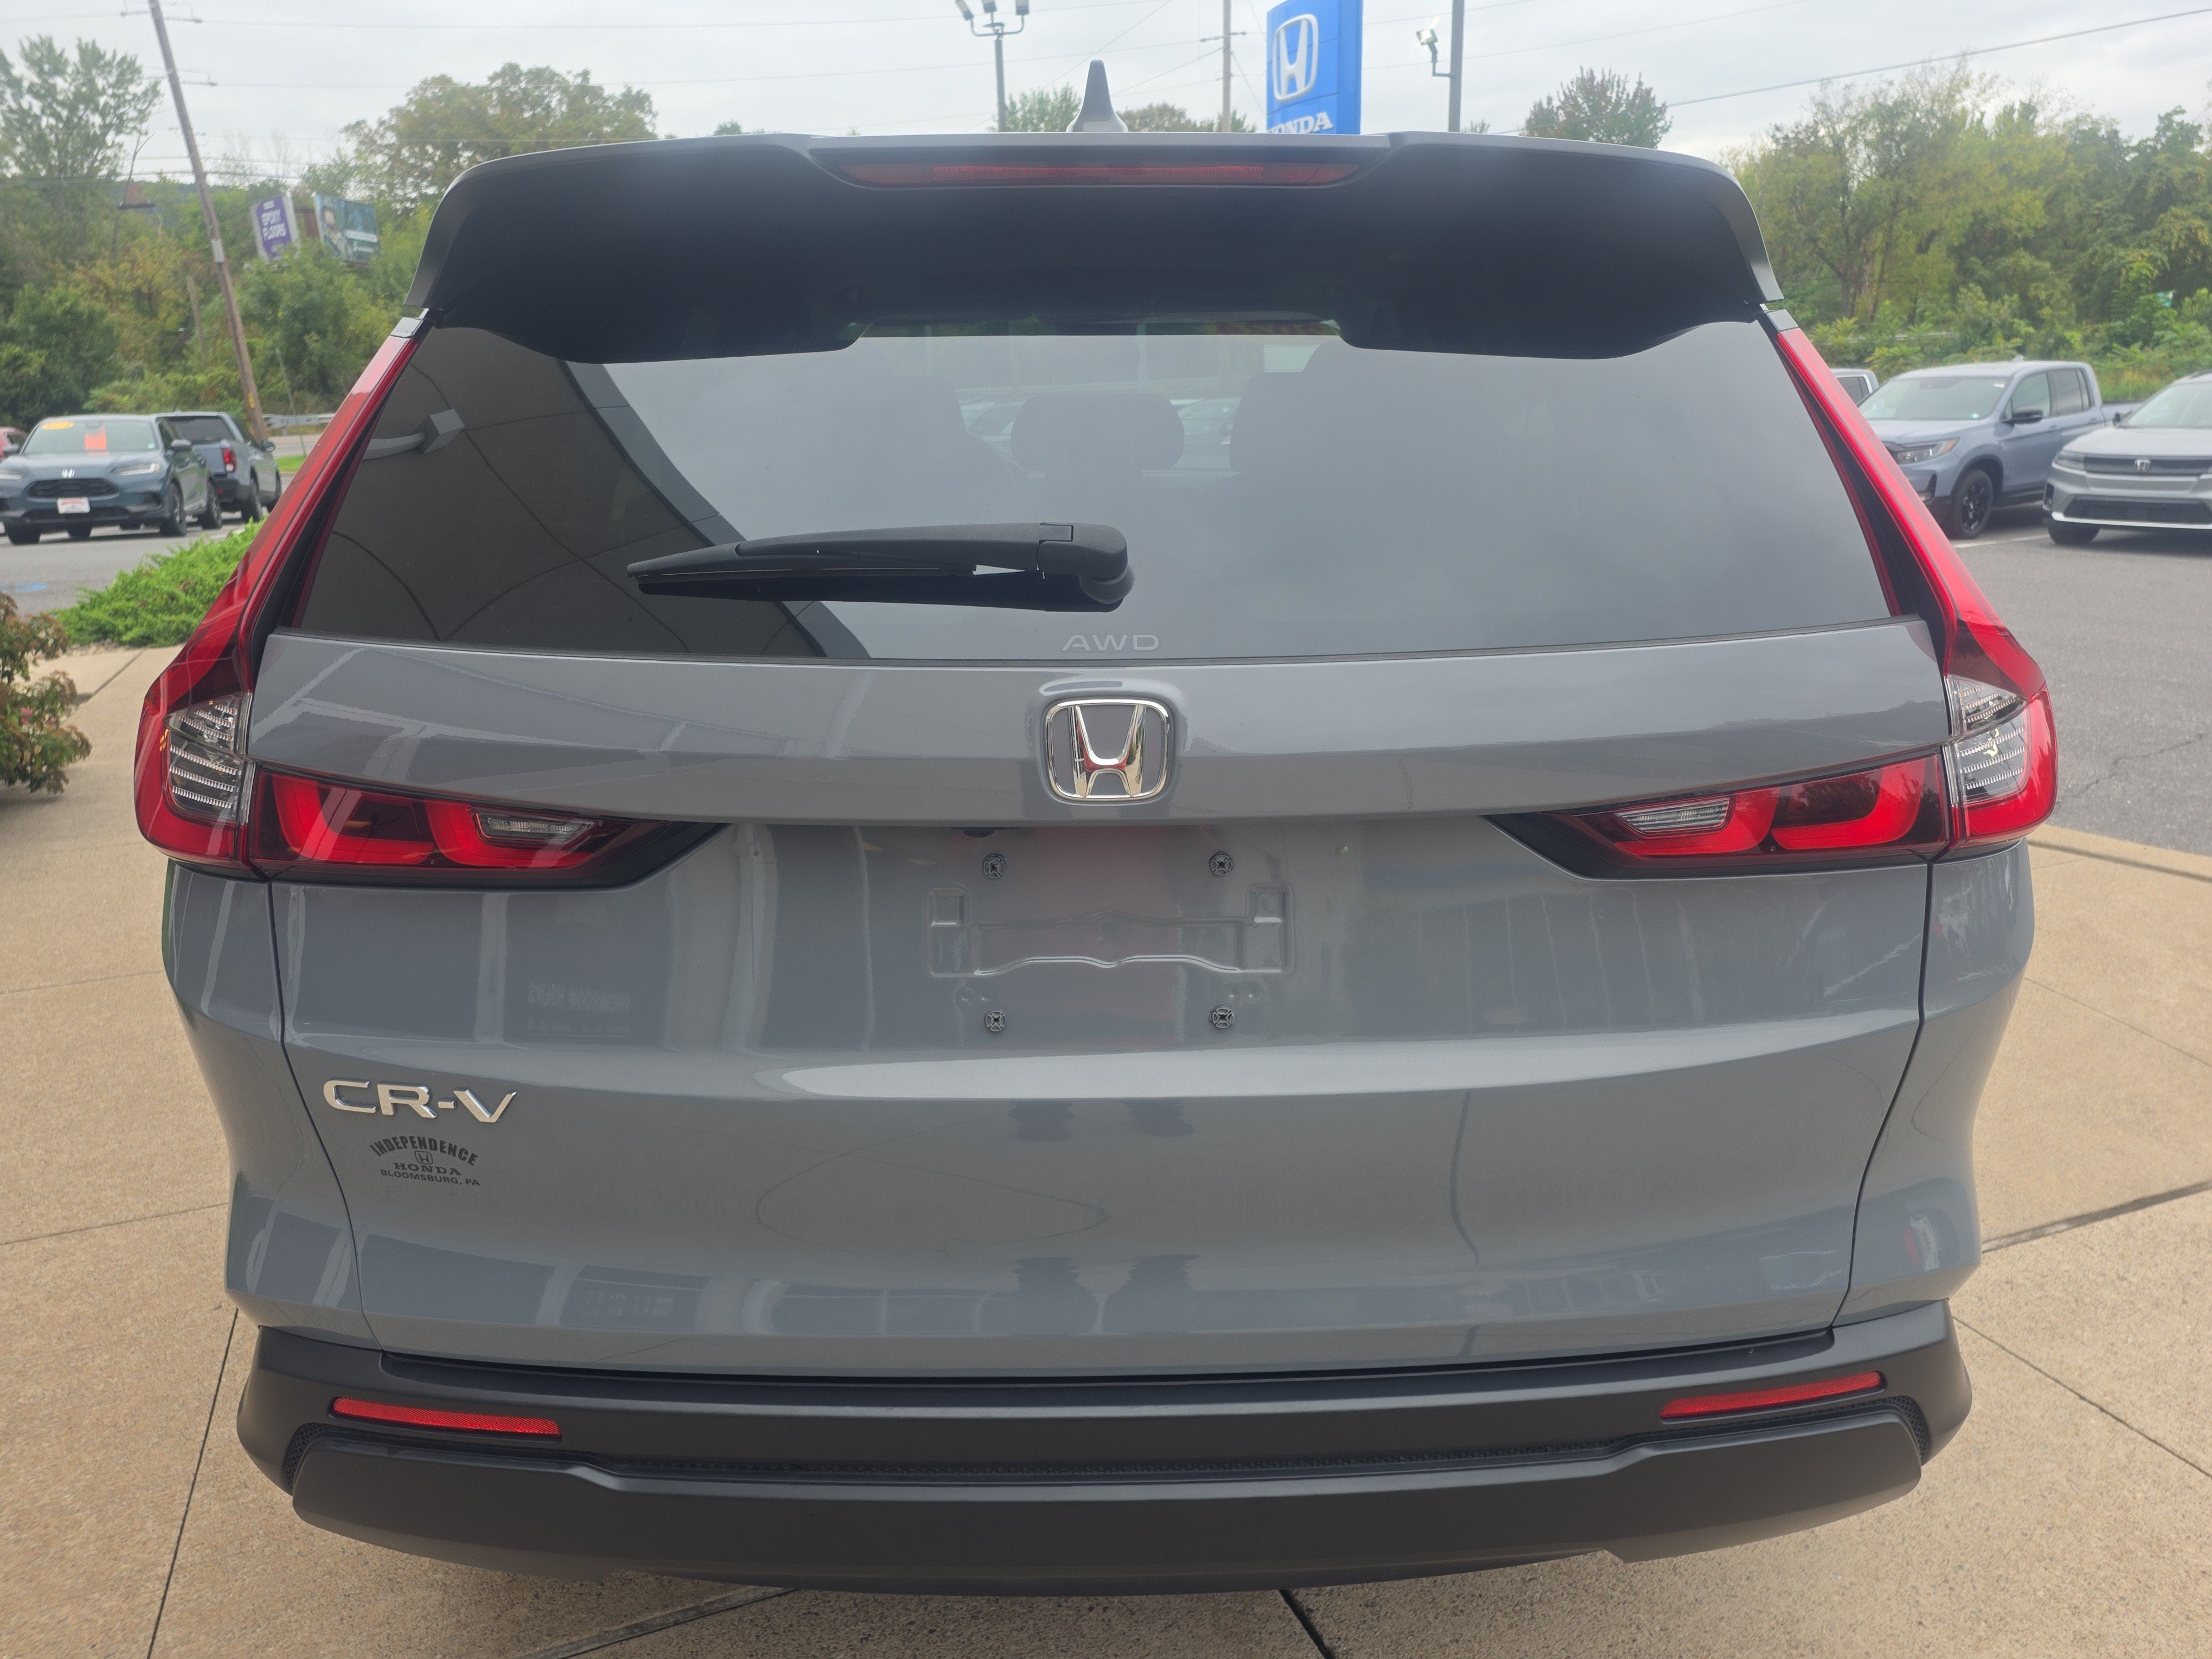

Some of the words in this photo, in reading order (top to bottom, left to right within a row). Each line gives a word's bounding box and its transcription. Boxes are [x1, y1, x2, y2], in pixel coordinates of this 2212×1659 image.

[1062, 634, 1159, 651] AWD
[323, 1079, 517, 1123] CR-V
[370, 1135, 478, 1166] INDEPENDENCE
[381, 1169, 462, 1185] BLOOMSBURG,
[393, 1162, 462, 1175] HONDA
